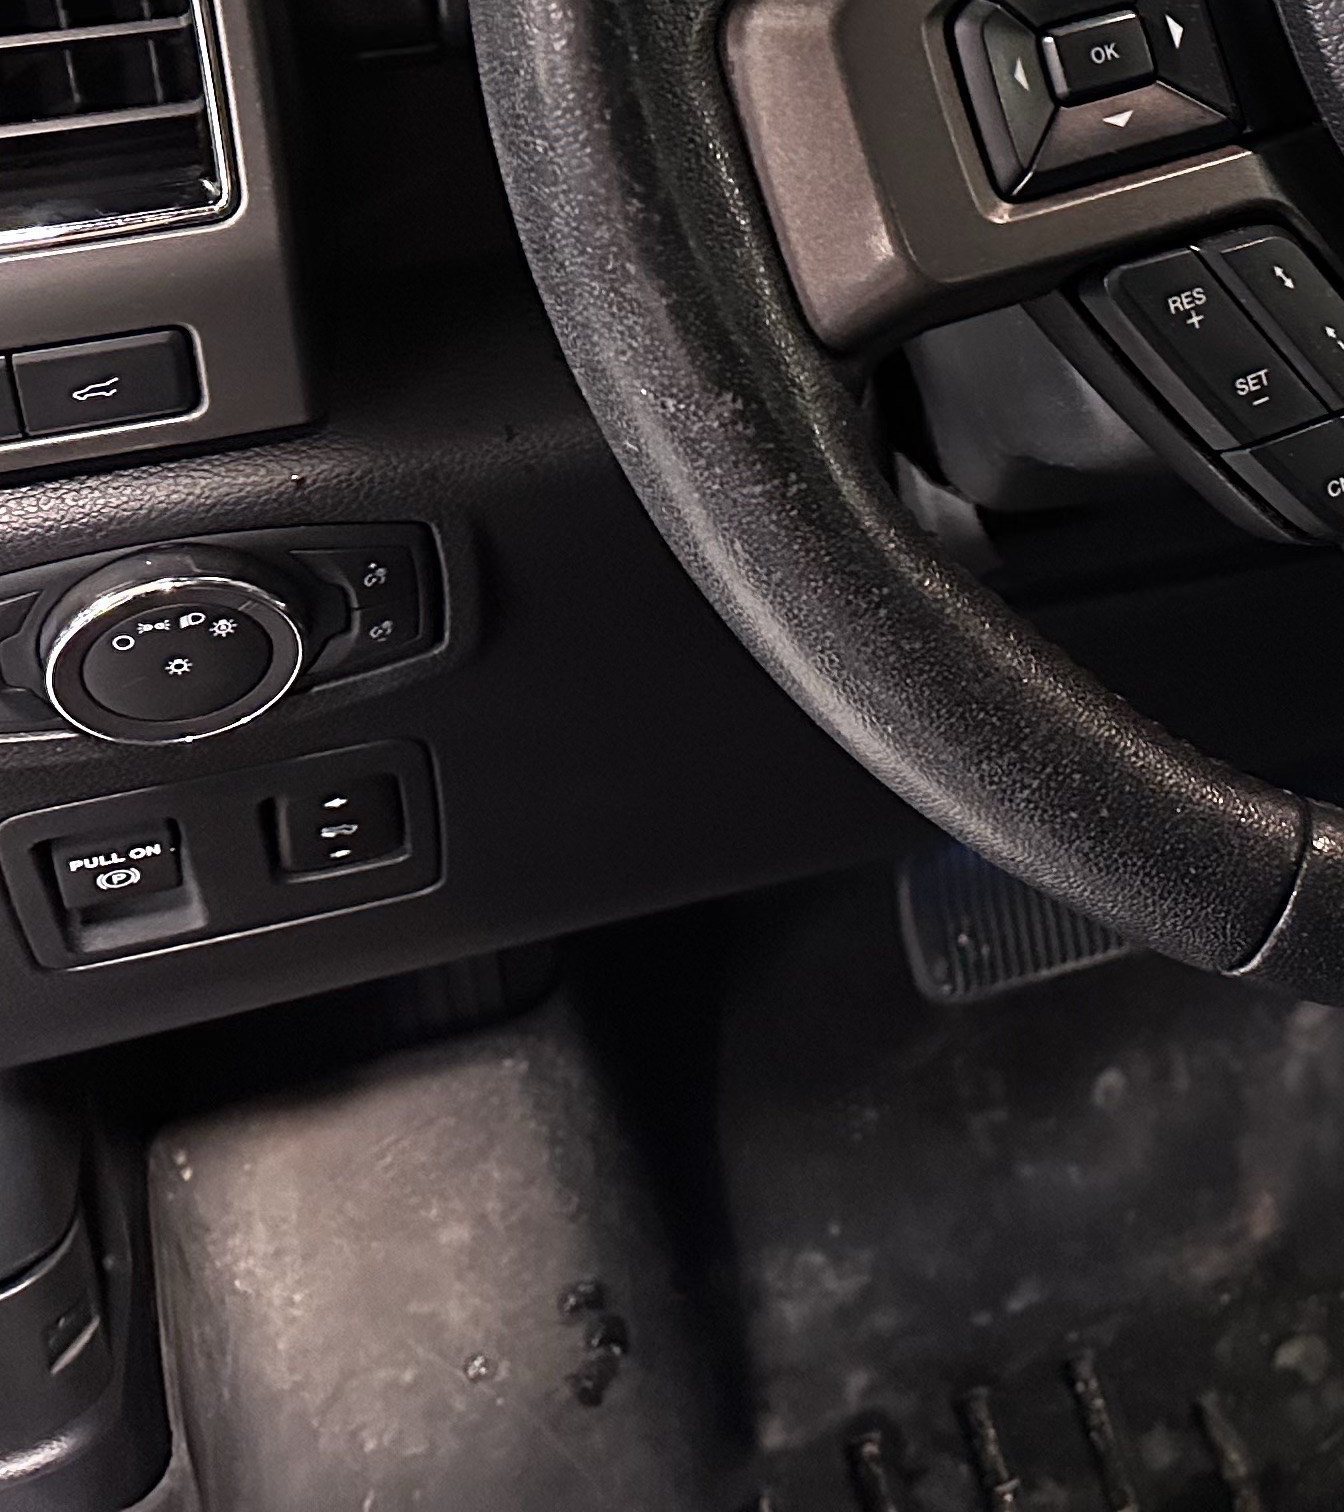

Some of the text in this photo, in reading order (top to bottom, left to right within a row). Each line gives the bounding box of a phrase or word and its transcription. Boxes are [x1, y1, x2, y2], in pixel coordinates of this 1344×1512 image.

[1090, 42, 1121, 65] OK
[1168, 288, 1207, 314] RES
[1235, 368, 1271, 396] SET
[69, 843, 162, 872] PULL ON
